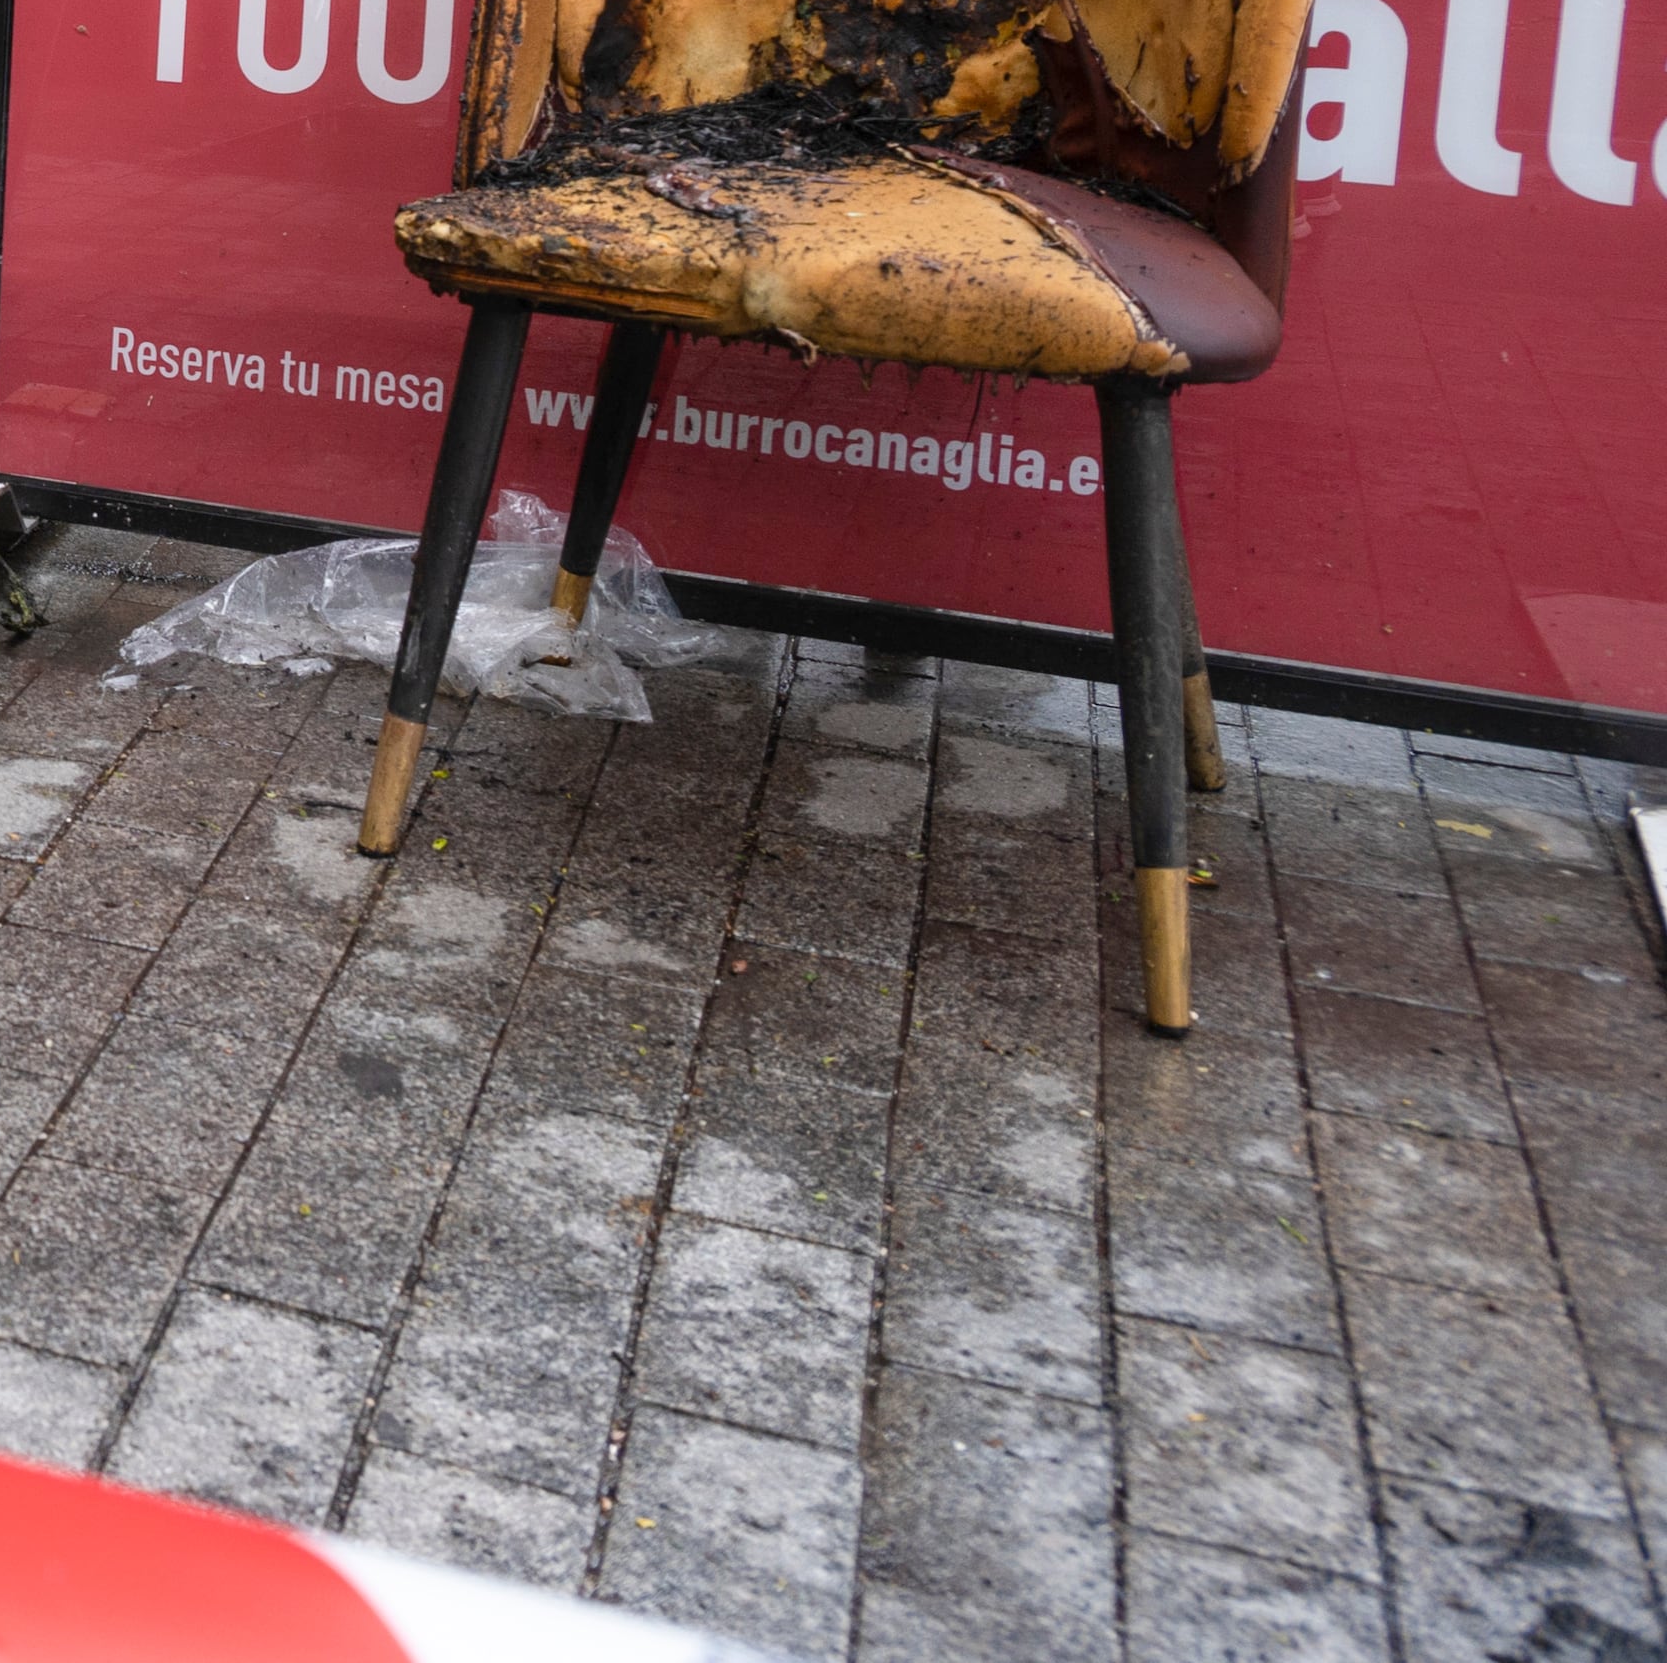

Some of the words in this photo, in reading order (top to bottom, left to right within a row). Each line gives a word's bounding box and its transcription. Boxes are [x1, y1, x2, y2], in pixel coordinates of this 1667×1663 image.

[111, 327, 265, 392] Reserva
[280, 351, 320, 397] tu
[335, 366, 444, 412] mesa
[525, 388, 1104, 496] ww.burrocanaglia.e
